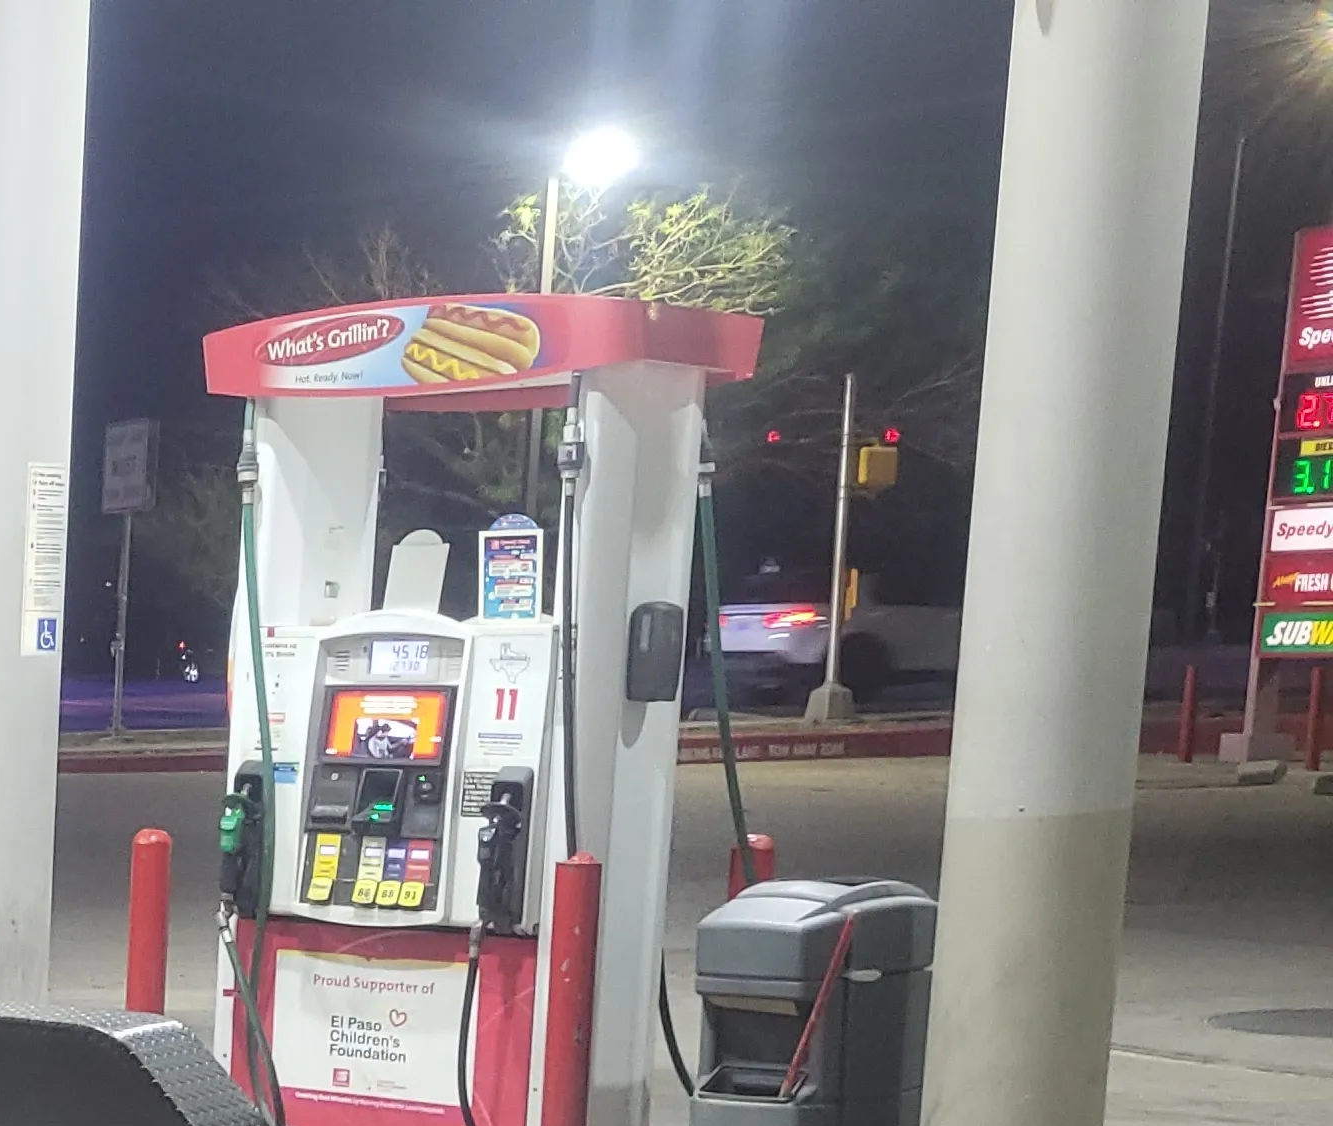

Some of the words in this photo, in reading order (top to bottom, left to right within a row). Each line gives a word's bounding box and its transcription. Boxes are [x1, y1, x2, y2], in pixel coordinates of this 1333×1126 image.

[266, 331, 325, 361] What's
[327, 318, 390, 349] Grillin'?
[1298, 326, 1333, 350] Spe
[1294, 573, 1329, 593] FRESH
[494, 687, 519, 721] 11
[313, 973, 351, 988] Proud
[353, 977, 418, 994] Supporter
[421, 982, 436, 995] of
[331, 1015, 344, 1028] El
[348, 1017, 382, 1032] Paso
[329, 1029, 401, 1048] Children's
[329, 1044, 407, 1063] Foundation
